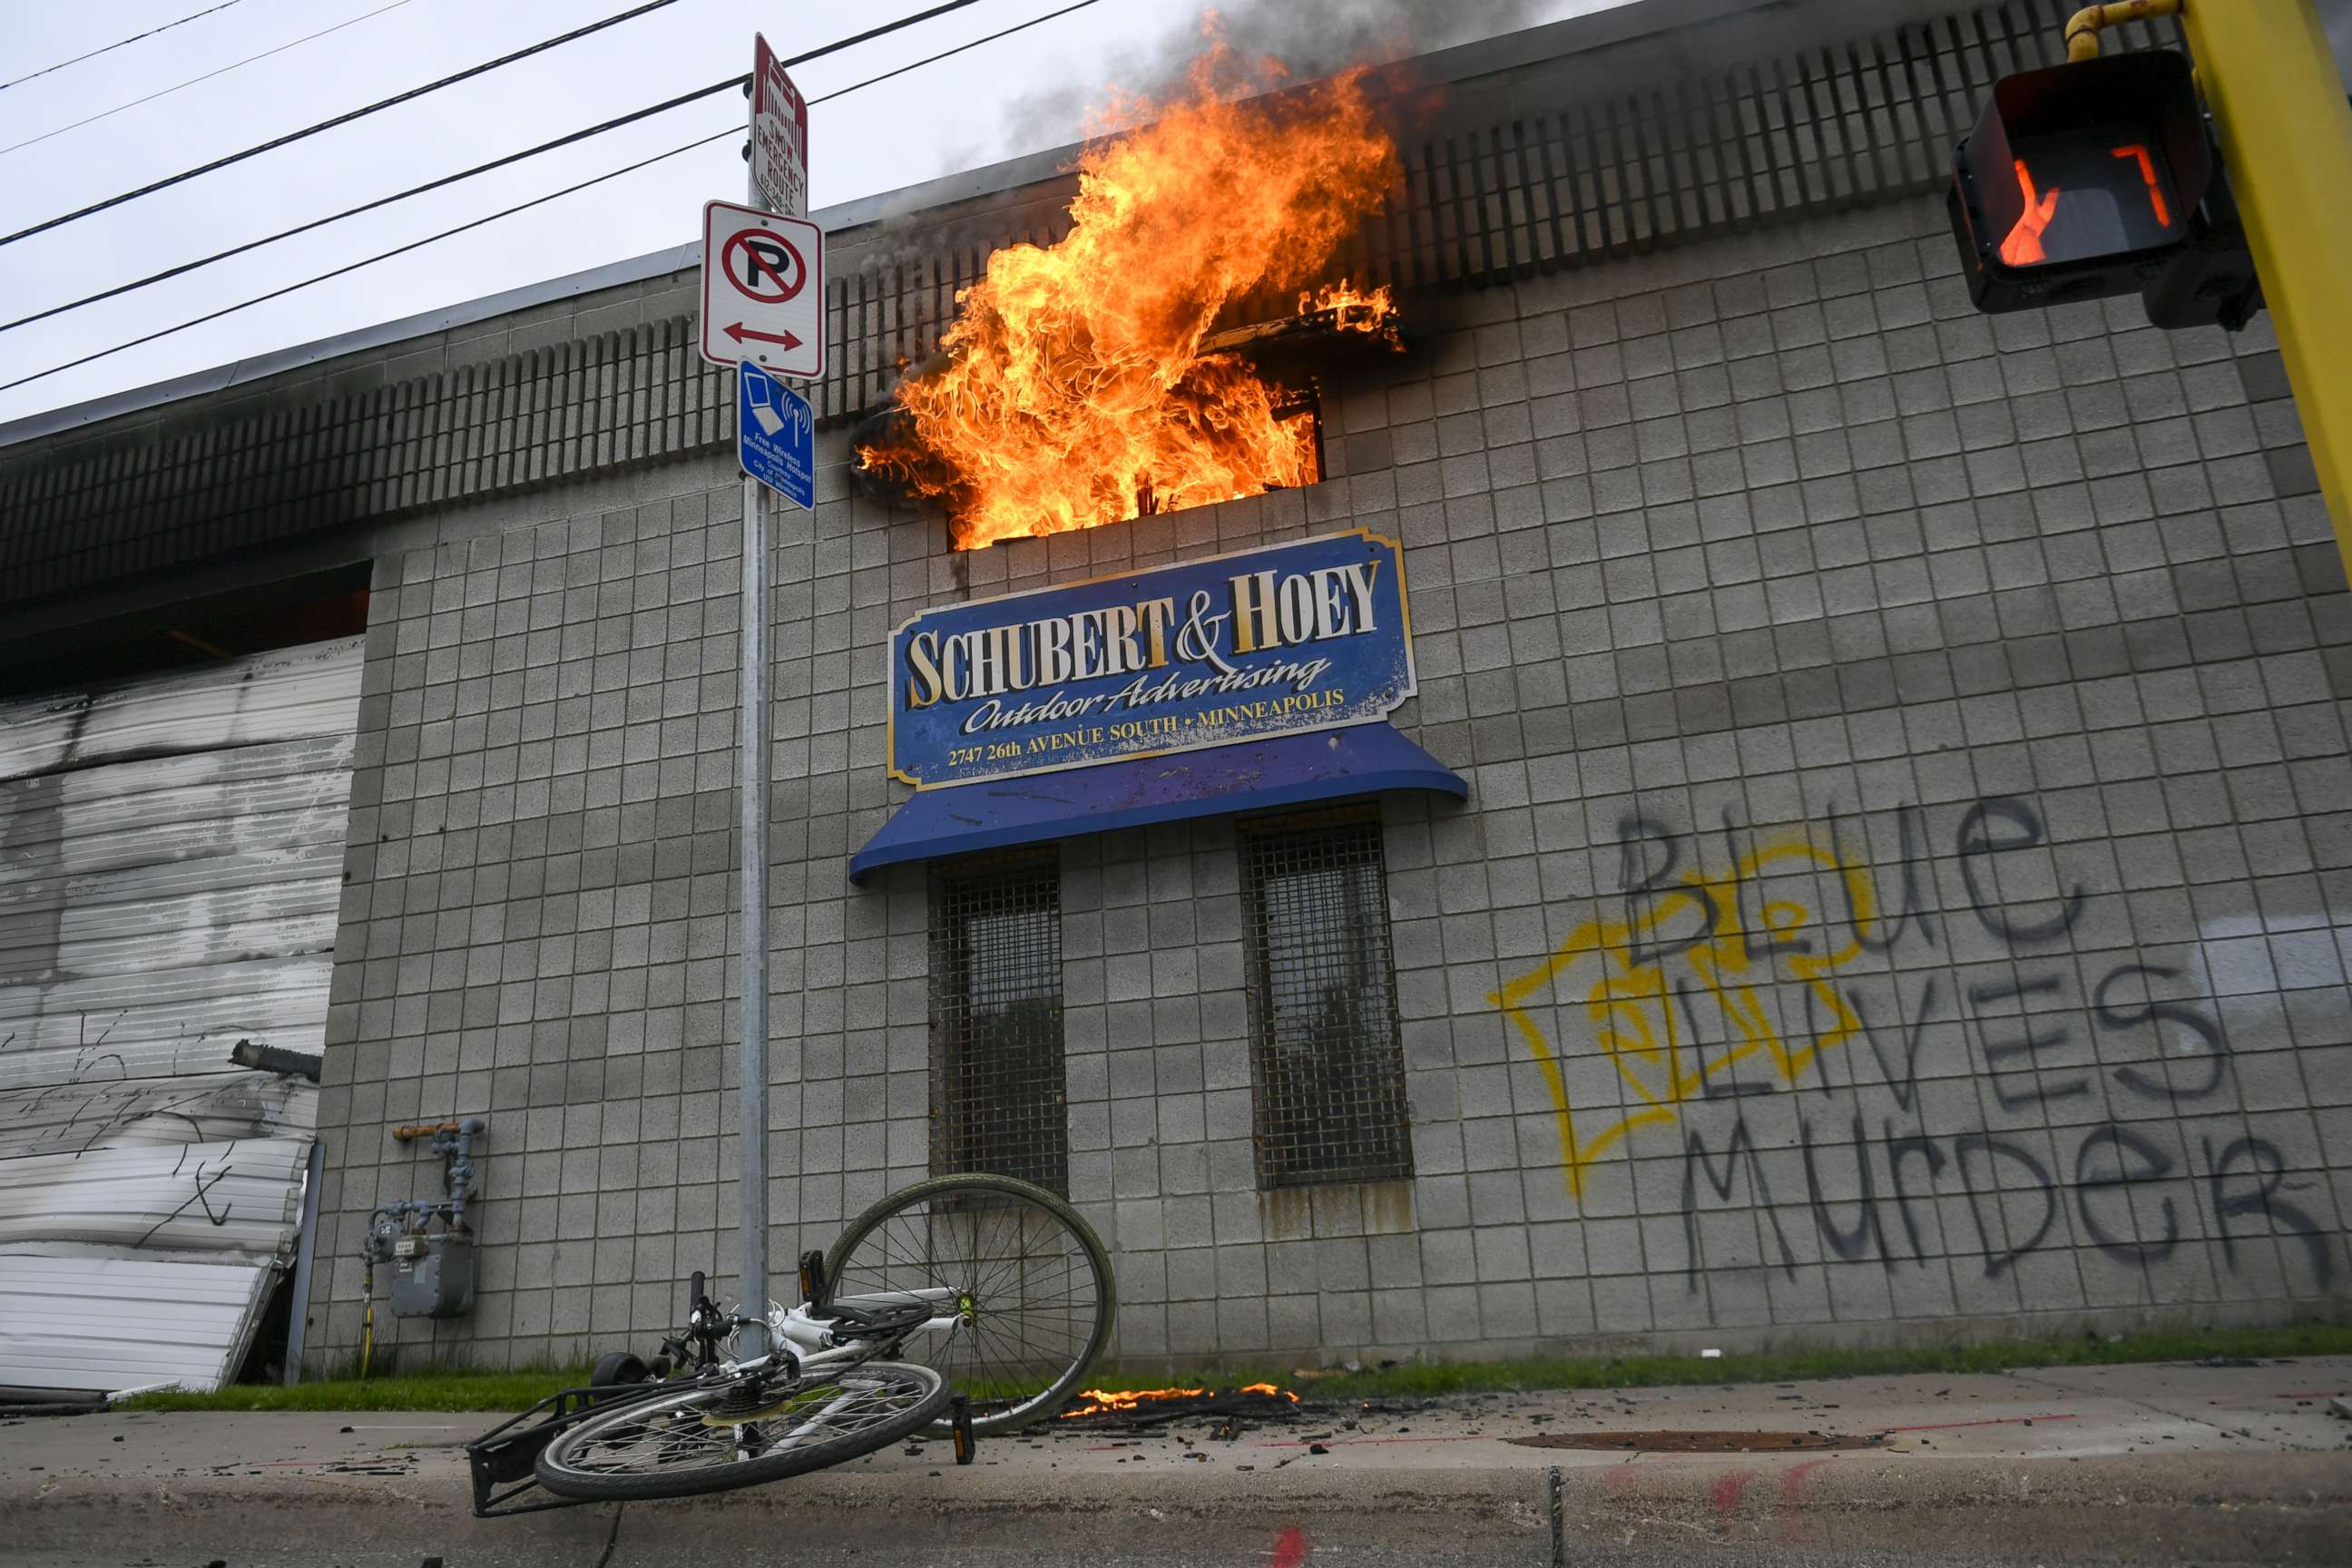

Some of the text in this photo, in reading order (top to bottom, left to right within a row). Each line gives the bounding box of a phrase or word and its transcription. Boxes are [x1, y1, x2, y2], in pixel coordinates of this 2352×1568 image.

[758, 123, 804, 198] EMERGENCY
[769, 119, 793, 163] SNOW
[767, 160, 795, 210] ROUTE
[2112, 144, 2171, 228] 7
[747, 240, 789, 287] P
[743, 435, 811, 484] Minneapolis Hotspot
[754, 432, 800, 467] Free Wireless
[909, 560, 1382, 708] SCHUBERT & HOEY
[948, 688, 1345, 767] 2747 26th AVENUE SOUTH MINNEAPOLIS
[965, 657, 1332, 733] Outdoor Advertising
[1675, 964, 2230, 1114] LIVES
